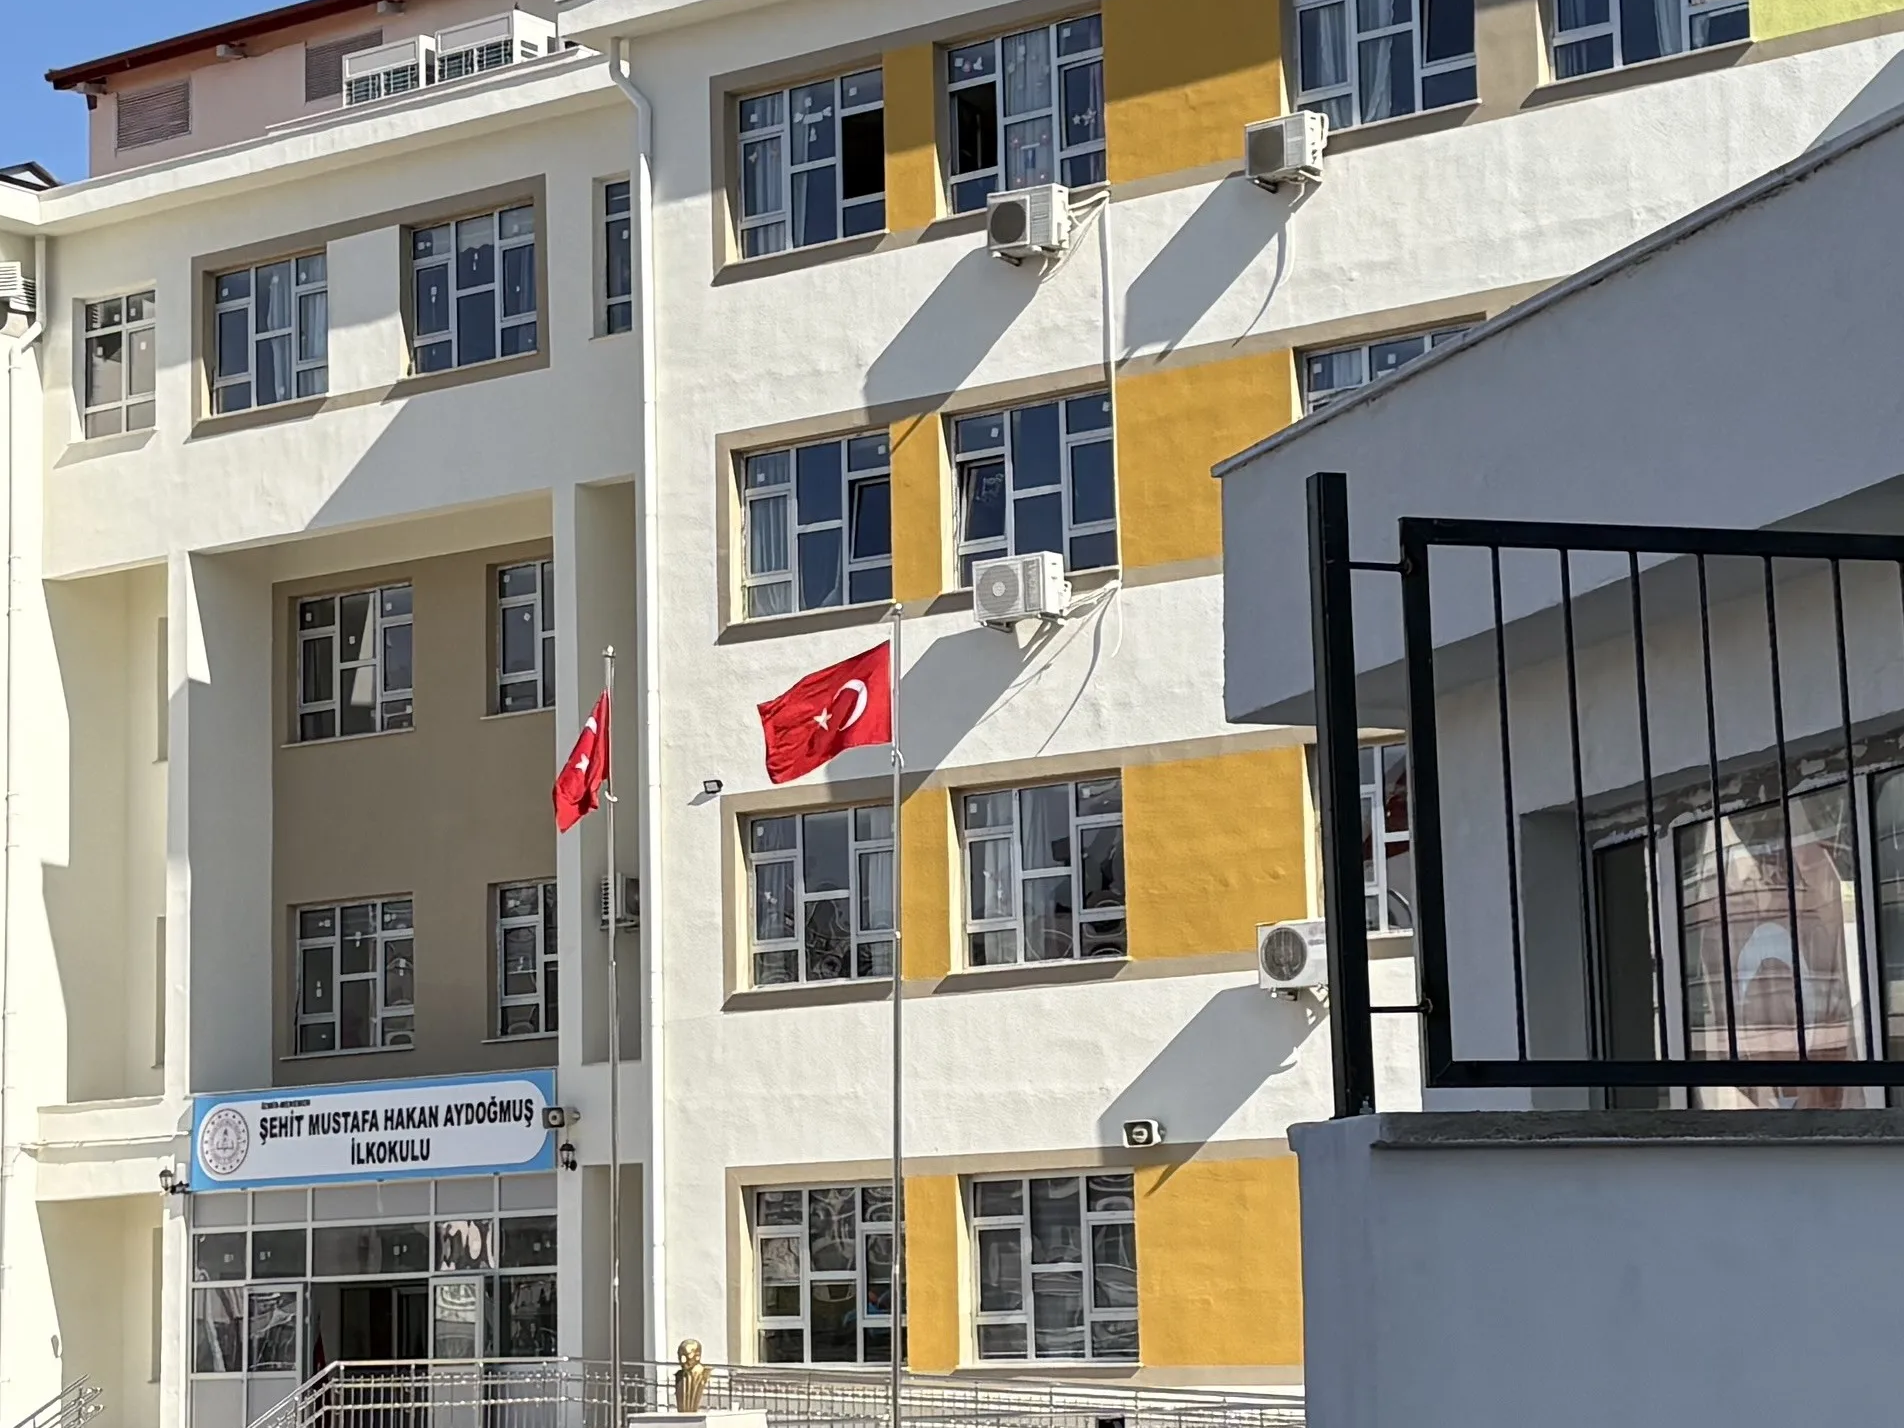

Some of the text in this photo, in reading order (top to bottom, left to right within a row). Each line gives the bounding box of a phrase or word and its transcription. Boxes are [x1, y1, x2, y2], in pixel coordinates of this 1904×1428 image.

[258, 1110, 304, 1146] ŞEHİT
[307, 1109, 380, 1136] MUSTAFA
[383, 1103, 440, 1131] HAKAN
[442, 1095, 535, 1128] AYDOĞMUŞ
[350, 1137, 431, 1166] İLKOKULU
